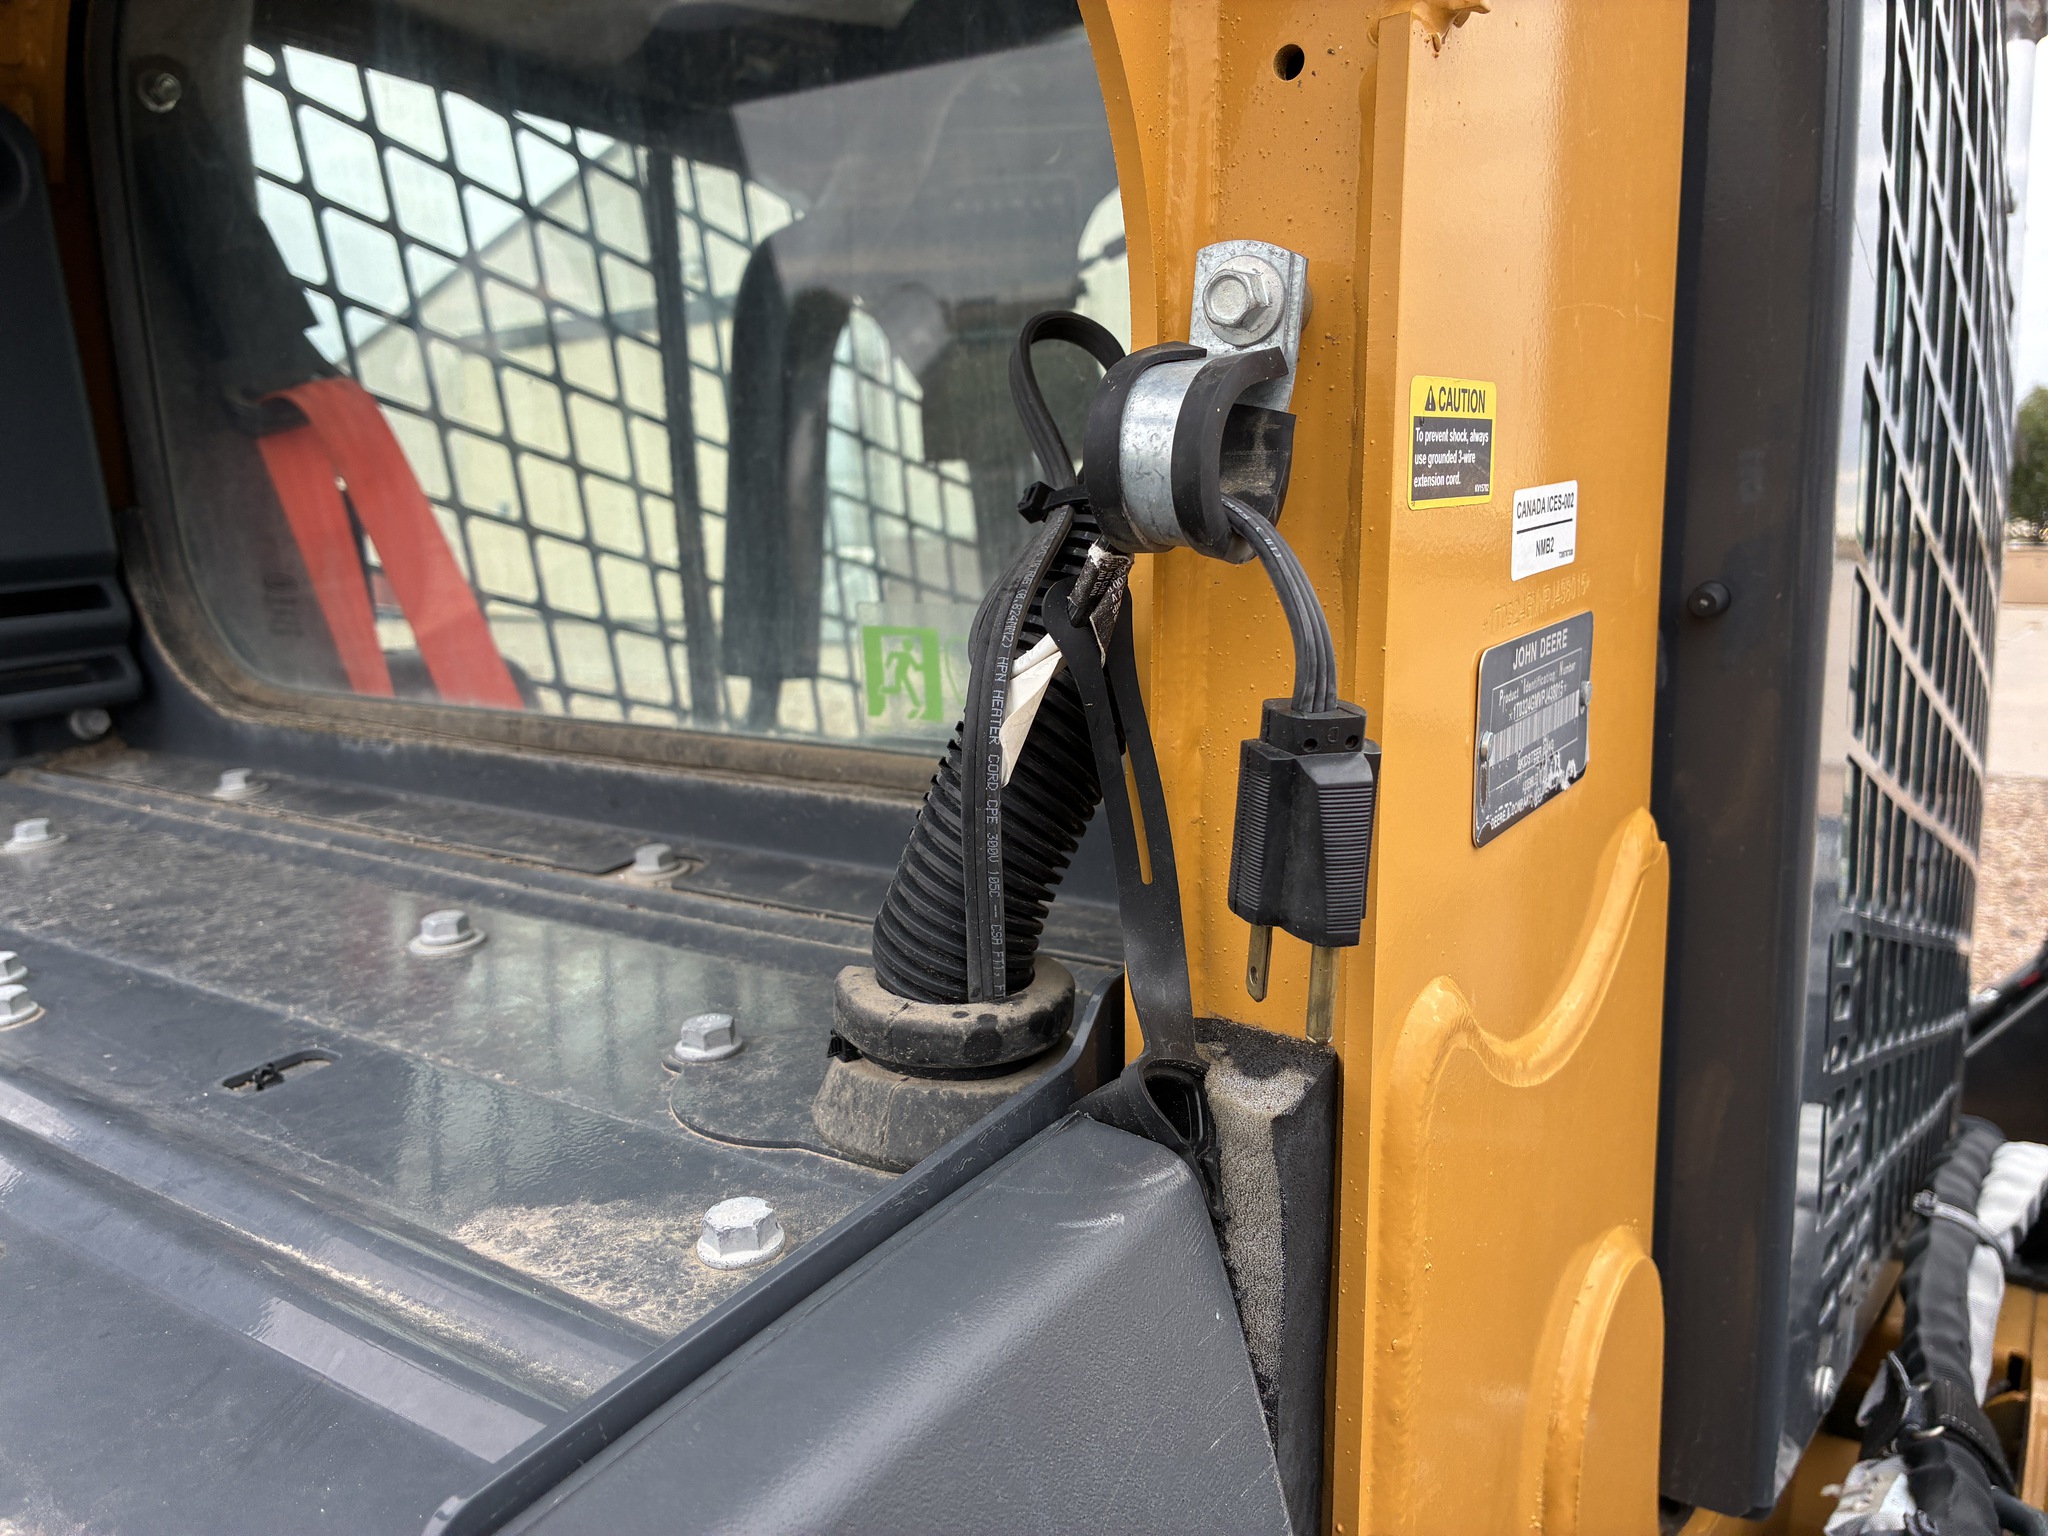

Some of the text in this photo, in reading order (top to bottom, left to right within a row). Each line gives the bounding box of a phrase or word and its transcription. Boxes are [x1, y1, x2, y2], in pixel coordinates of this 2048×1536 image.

[1439, 386, 1486, 413] CAUTION
[1415, 427, 1489, 446] To prevent shock, always
[1414, 449, 1476, 468] use grounded 3-wire
[1413, 472, 1461, 488] extension cord.
[1516, 492, 1575, 519] CANADA ICES-002
[1535, 536, 1555, 557] NMB2
[1512, 627, 1569, 671] JOHN DEERE
[994, 656, 1010, 682] HPN
[1499, 686, 1519, 706] Product
[988, 689, 1005, 745] HEATER
[986, 754, 1000, 791] CORD
[986, 799, 999, 824] CPE
[987, 832, 999, 863] 300V
[988, 870, 1001, 898] 105C
[991, 924, 1003, 946] CSA
